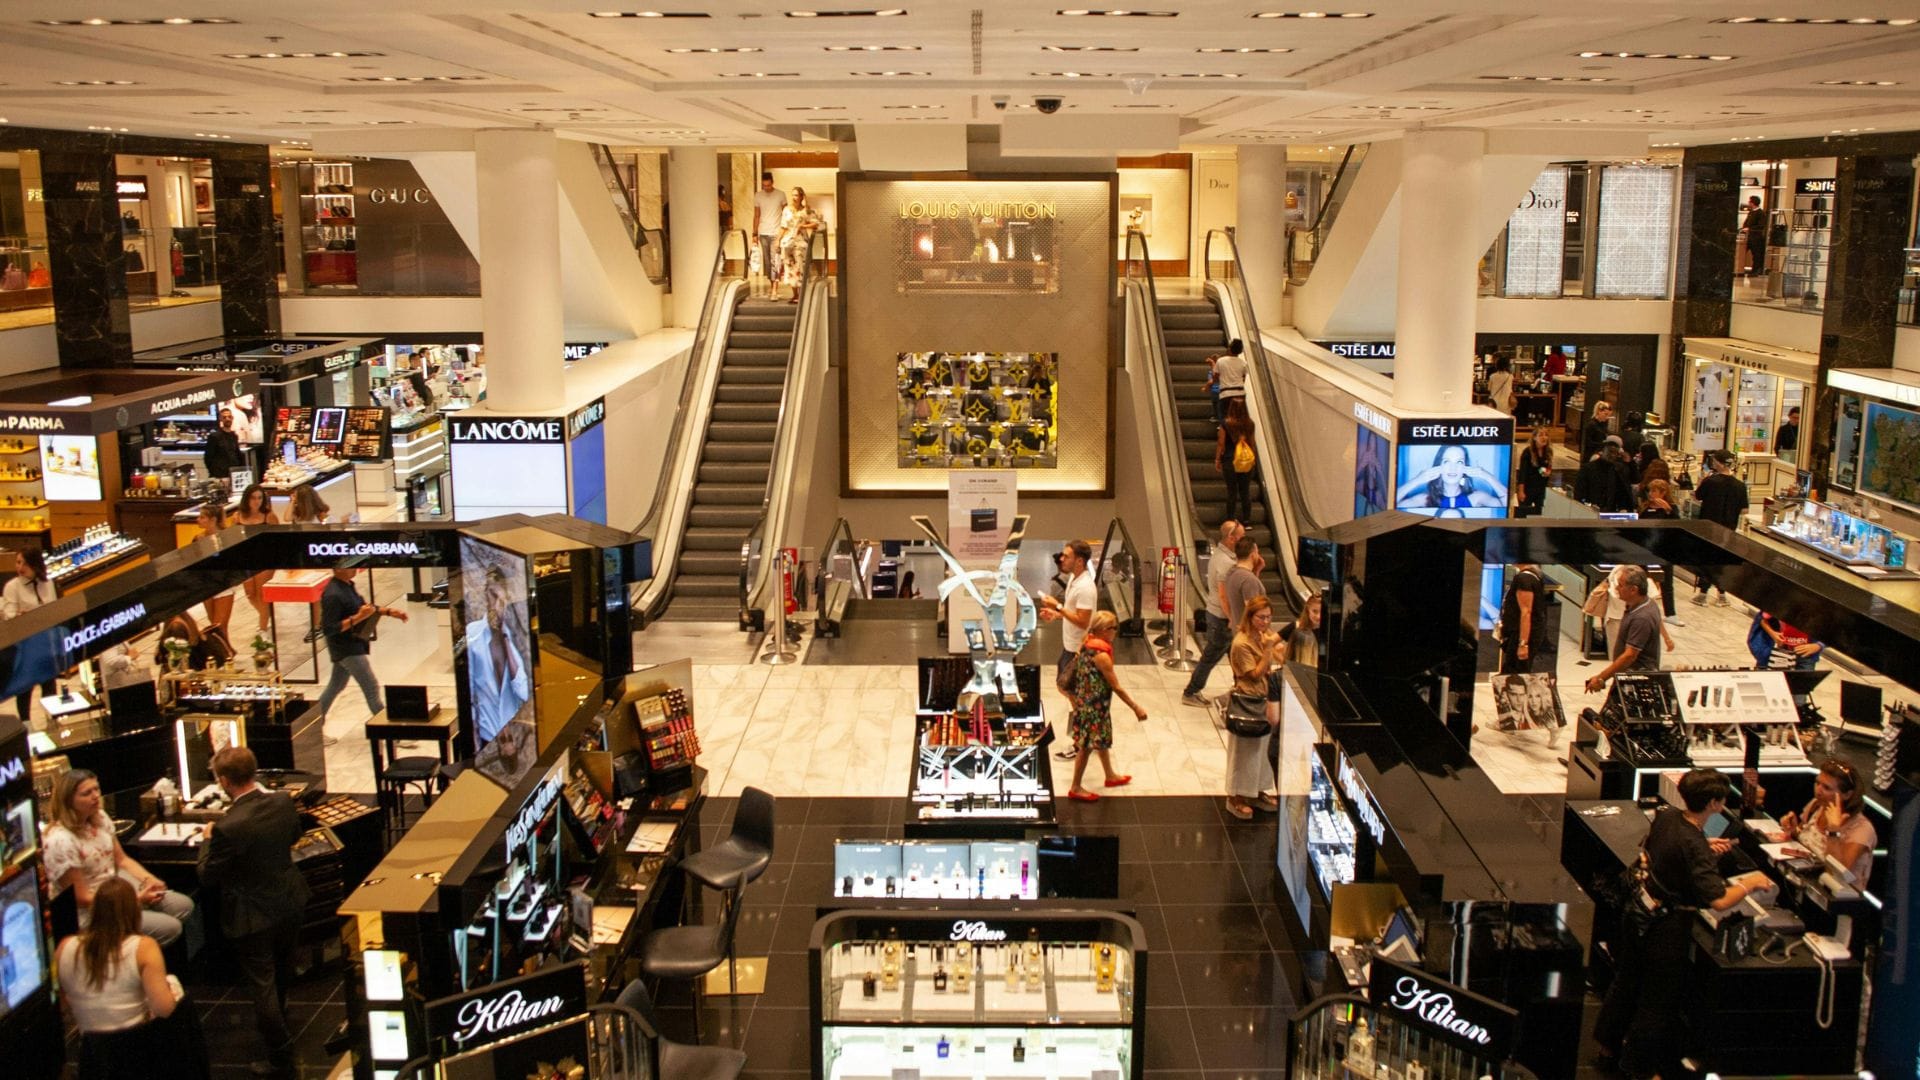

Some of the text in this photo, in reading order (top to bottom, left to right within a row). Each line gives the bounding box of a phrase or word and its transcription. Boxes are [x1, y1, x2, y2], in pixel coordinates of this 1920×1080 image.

[900, 202, 1057, 218] LOUIS VUITTON
[151, 397, 182, 415] ACQUA
[187, 388, 217, 405] PARMA
[8, 416, 65, 430] PARMA
[453, 420, 561, 440] LANCÔME
[1450, 426, 1499, 438] LAUDER
[452, 989, 565, 1042] Kilian
[1390, 976, 1491, 1045] Kilian
